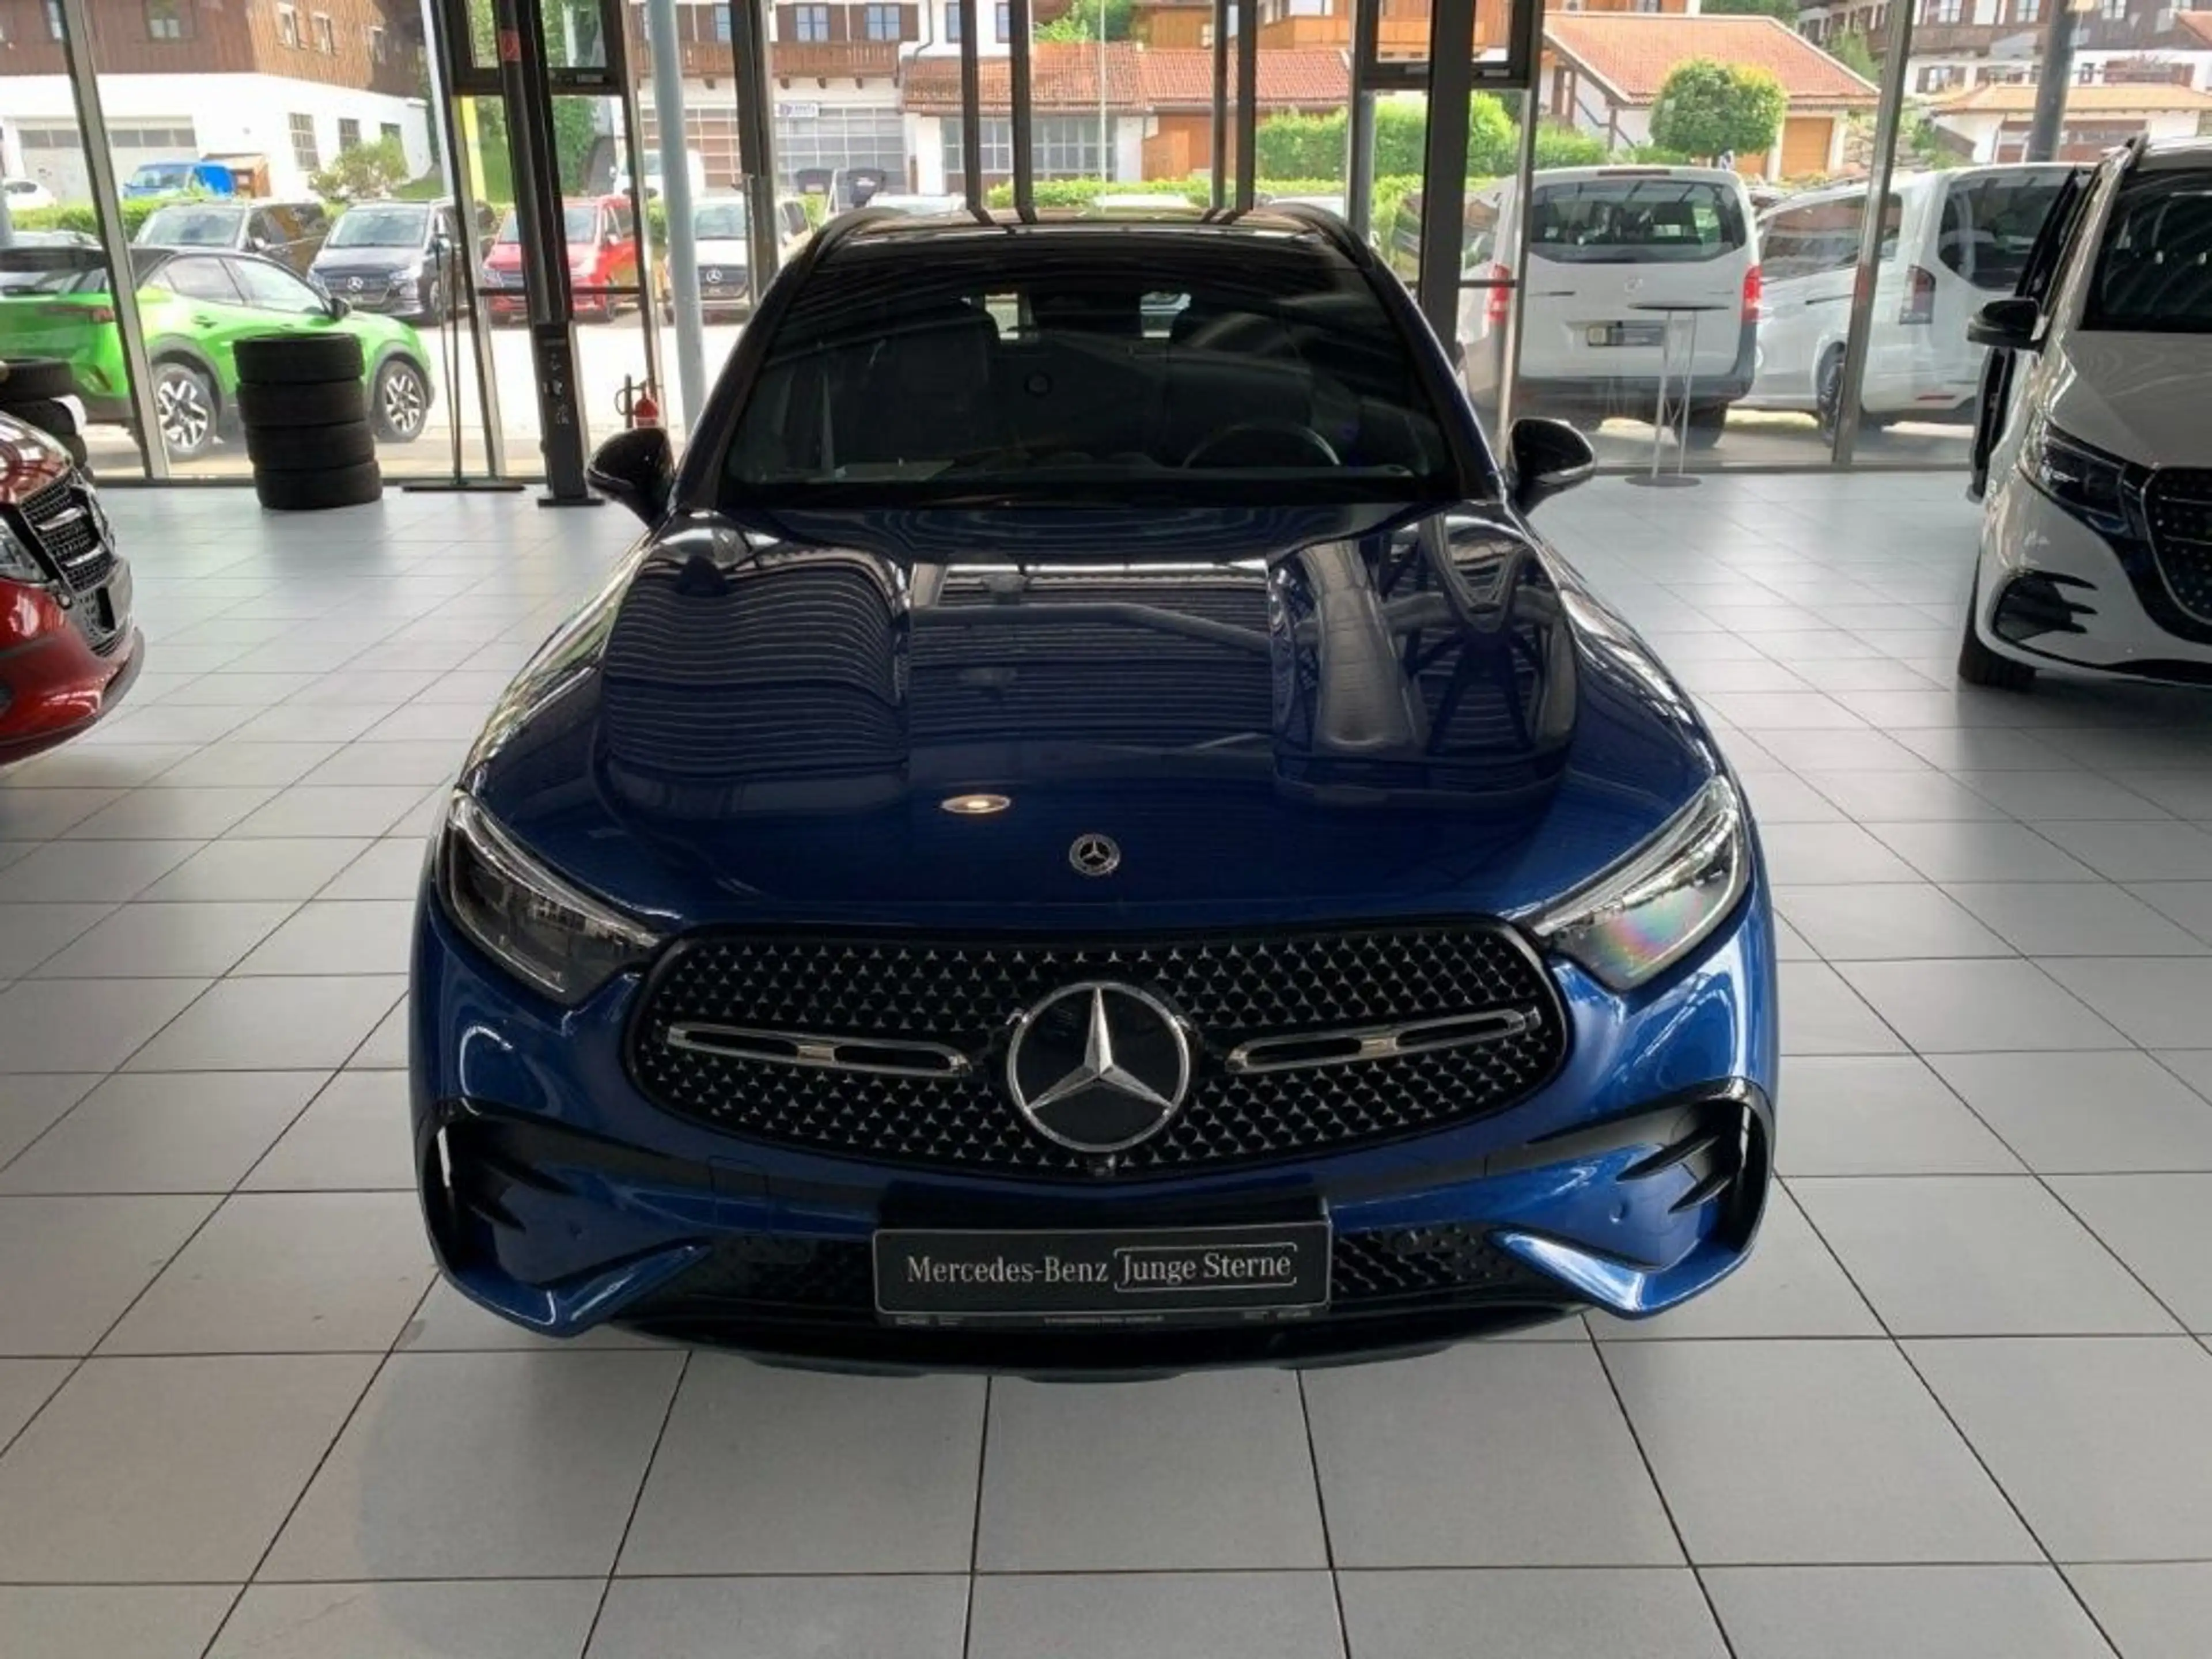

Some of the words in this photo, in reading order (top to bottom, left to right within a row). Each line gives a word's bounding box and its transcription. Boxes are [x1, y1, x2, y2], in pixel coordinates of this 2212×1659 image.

[907, 1255, 1108, 1283] Mercedes-Benz
[1122, 1254, 1196, 1285] Junge
[1203, 1252, 1291, 1277] Sterne
